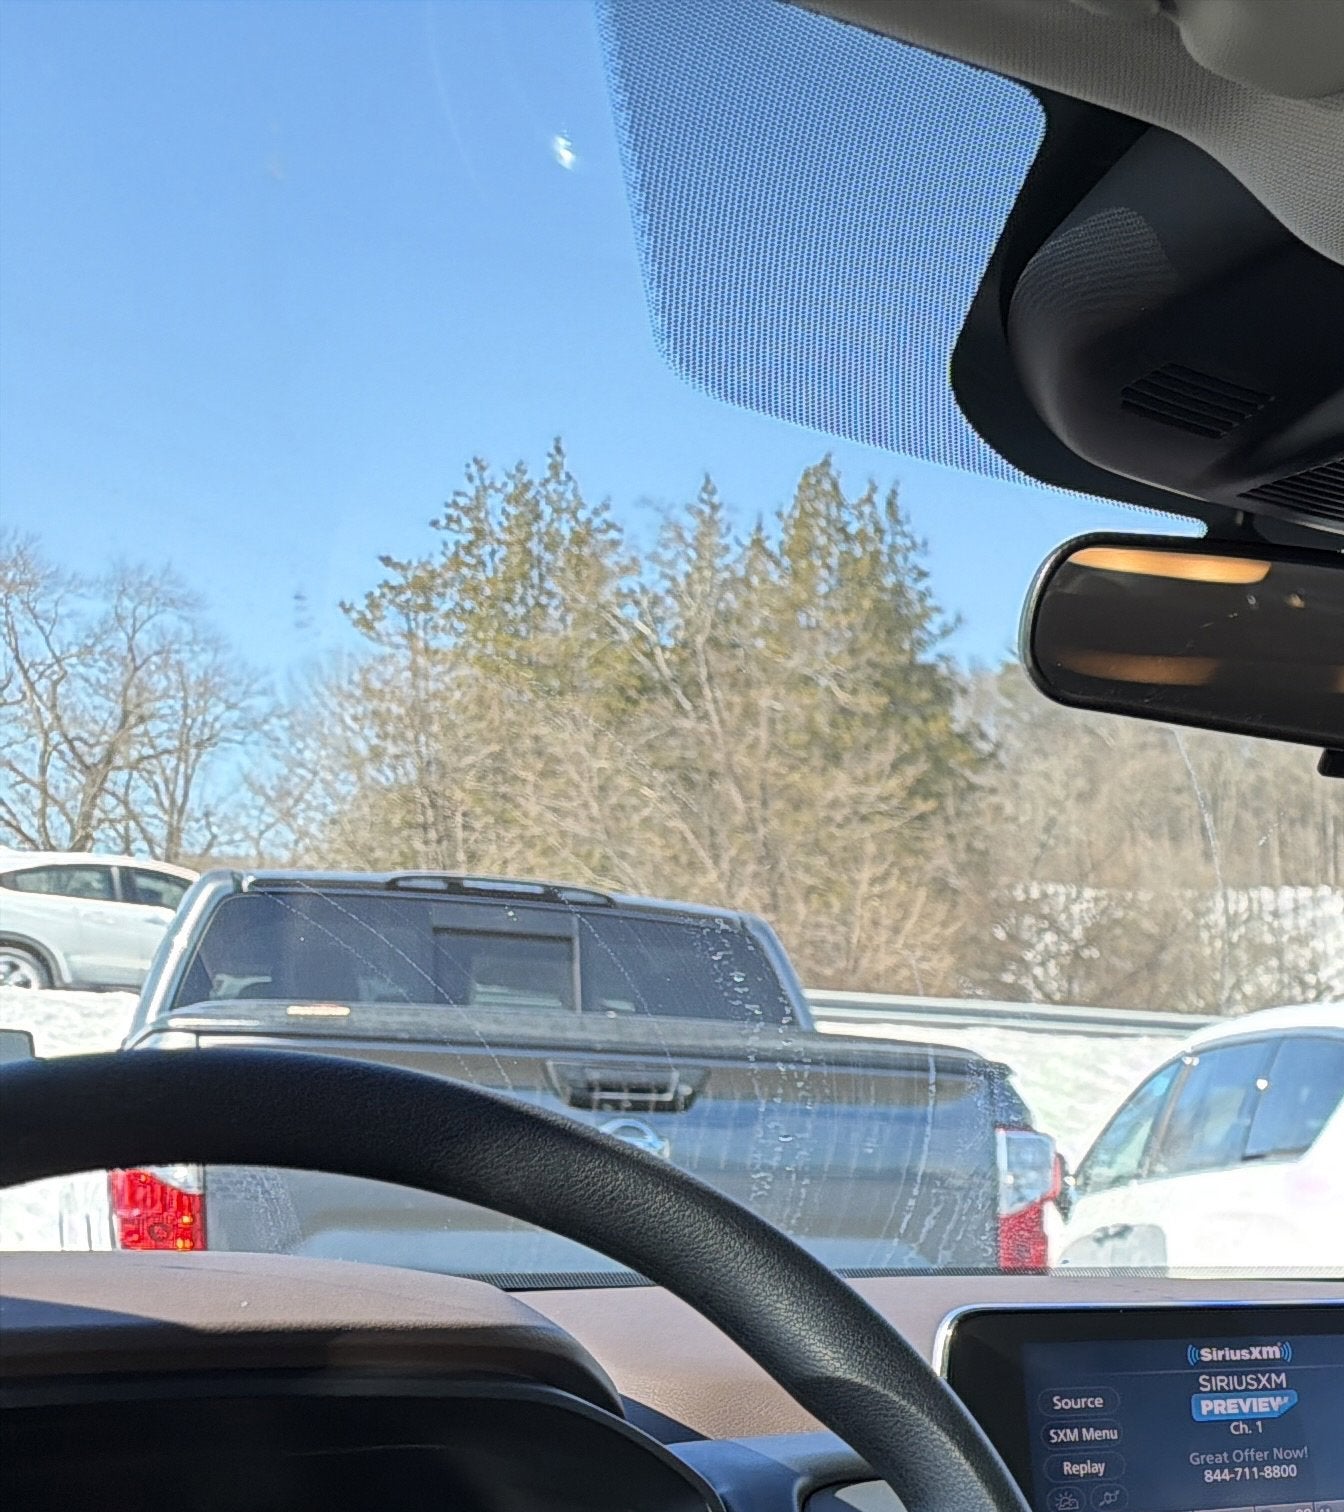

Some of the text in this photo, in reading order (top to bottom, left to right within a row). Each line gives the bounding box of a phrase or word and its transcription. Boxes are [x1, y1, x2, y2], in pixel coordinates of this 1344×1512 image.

[1199, 1372, 1287, 1392] SIRIUSXM
[1052, 1395, 1104, 1410] Source
[1200, 1396, 1289, 1416] PREVIEW
[1049, 1427, 1118, 1443] SXM Menu
[1230, 1421, 1263, 1435] Ch. 1
[1189, 1446, 1309, 1466] Great Offer Now!
[1063, 1460, 1105, 1478] Replay
[1203, 1465, 1298, 1483] 844-711-8800
